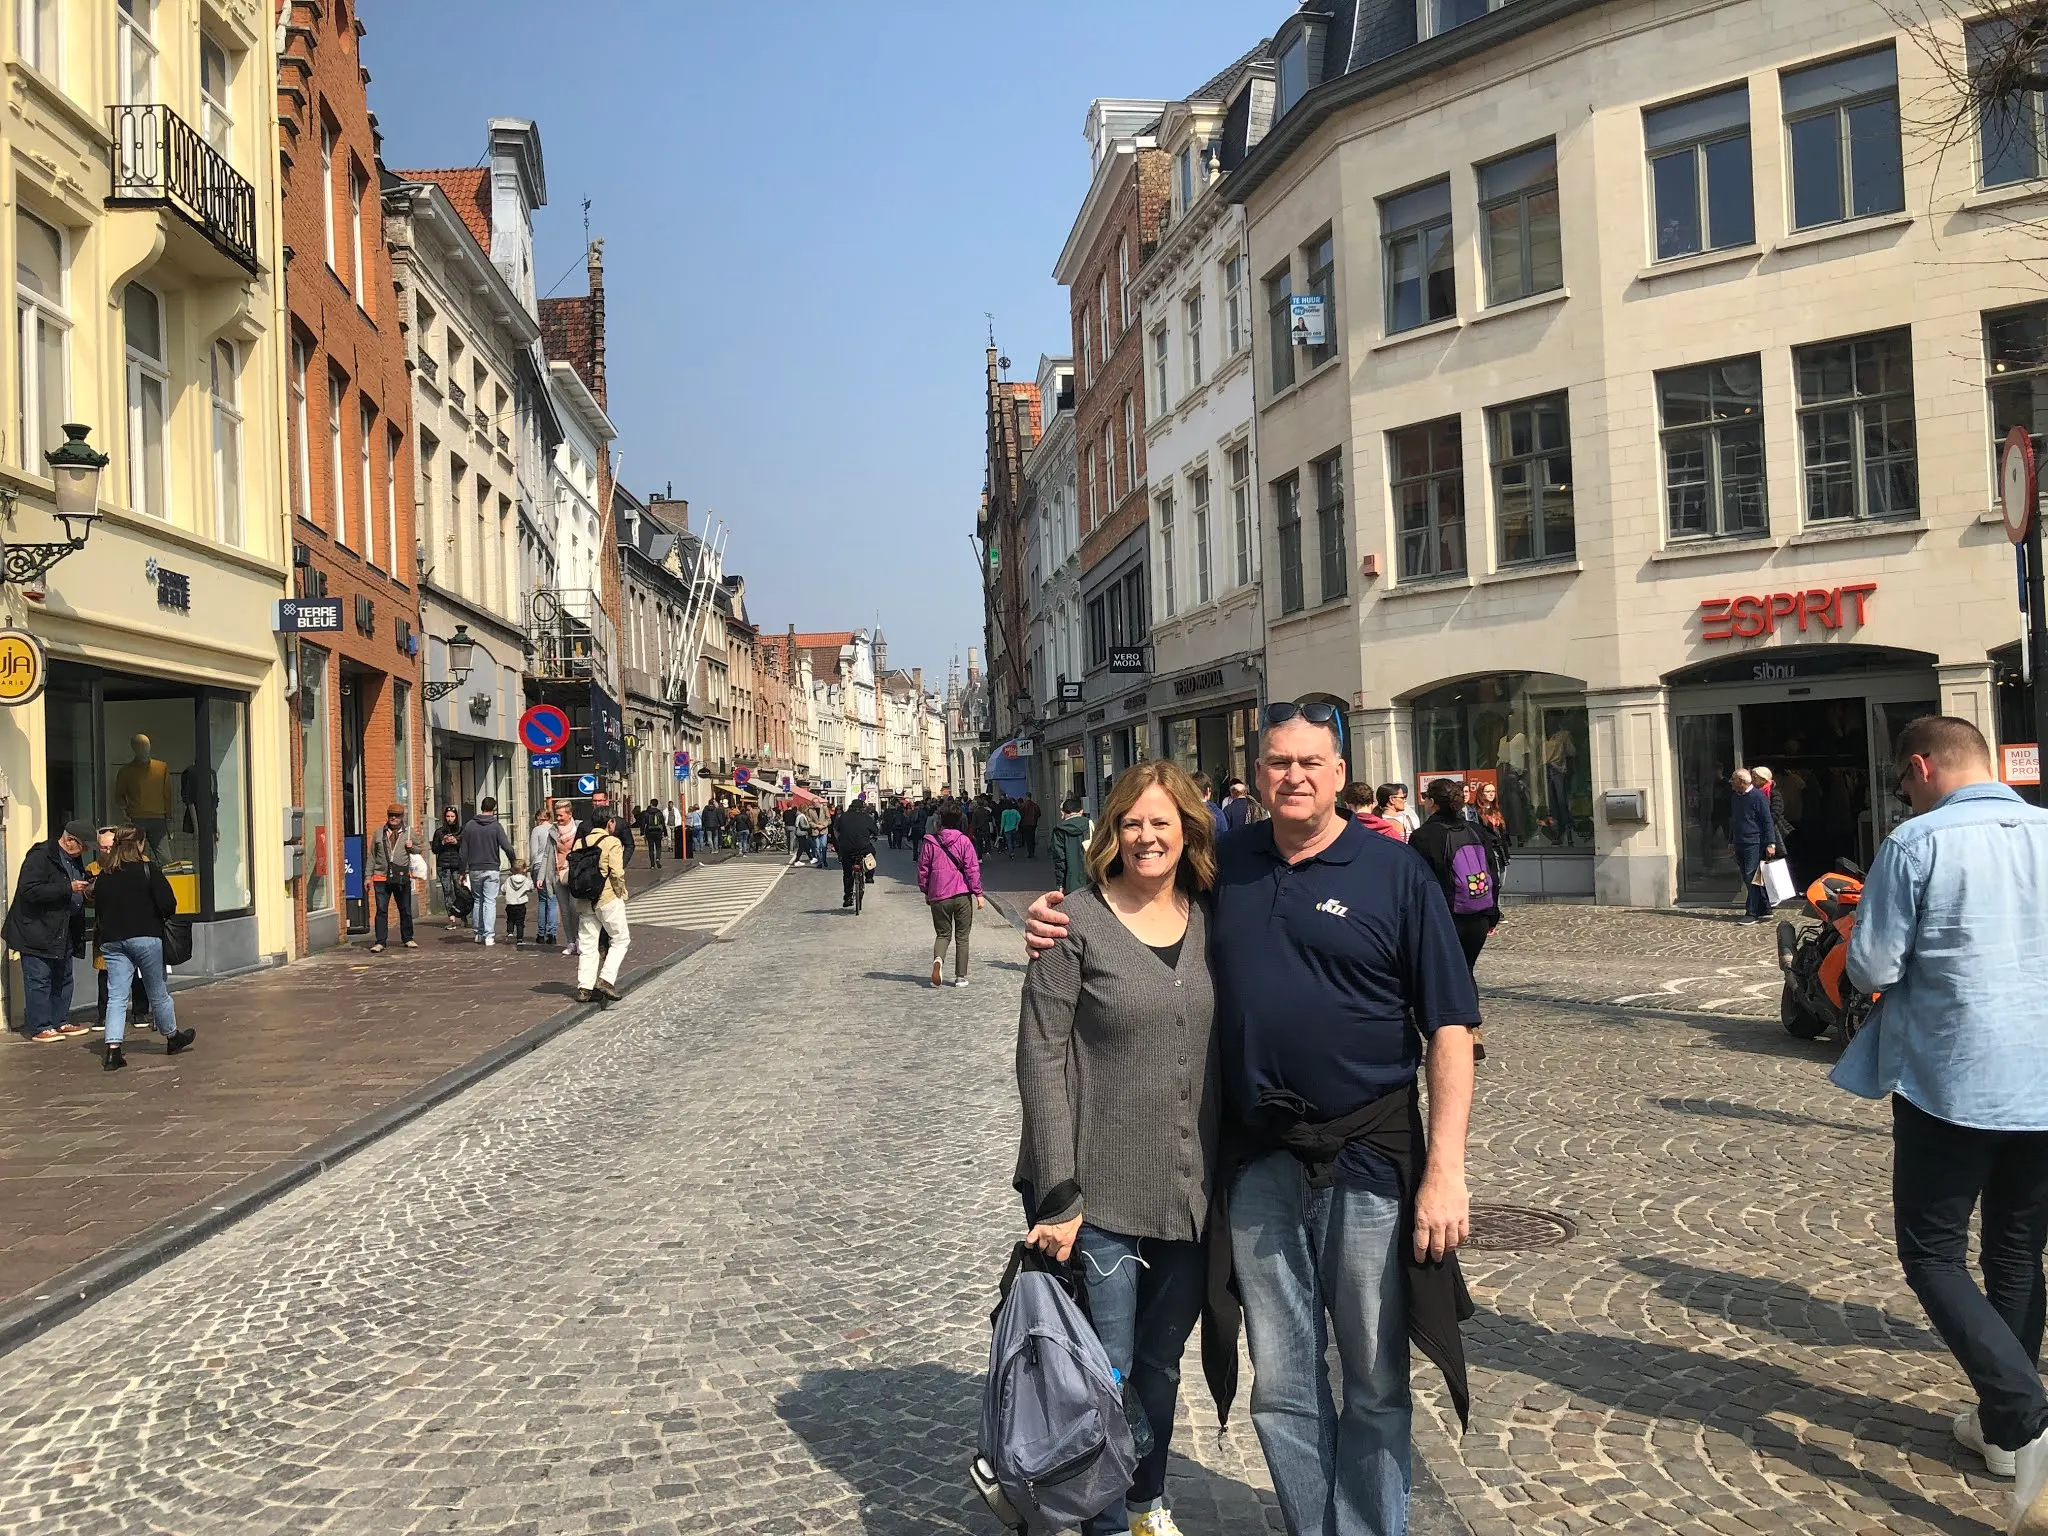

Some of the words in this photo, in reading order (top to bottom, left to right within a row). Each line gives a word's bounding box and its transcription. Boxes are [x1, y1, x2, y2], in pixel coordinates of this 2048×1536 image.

[297, 606, 337, 617] TERRE
[1700, 583, 1877, 640] ESPRIT
[297, 617, 337, 628] BLEUE
[1112, 659, 1142, 667] MODA
[2011, 750, 2031, 758] MID
[2011, 758, 2040, 766] SEAS
